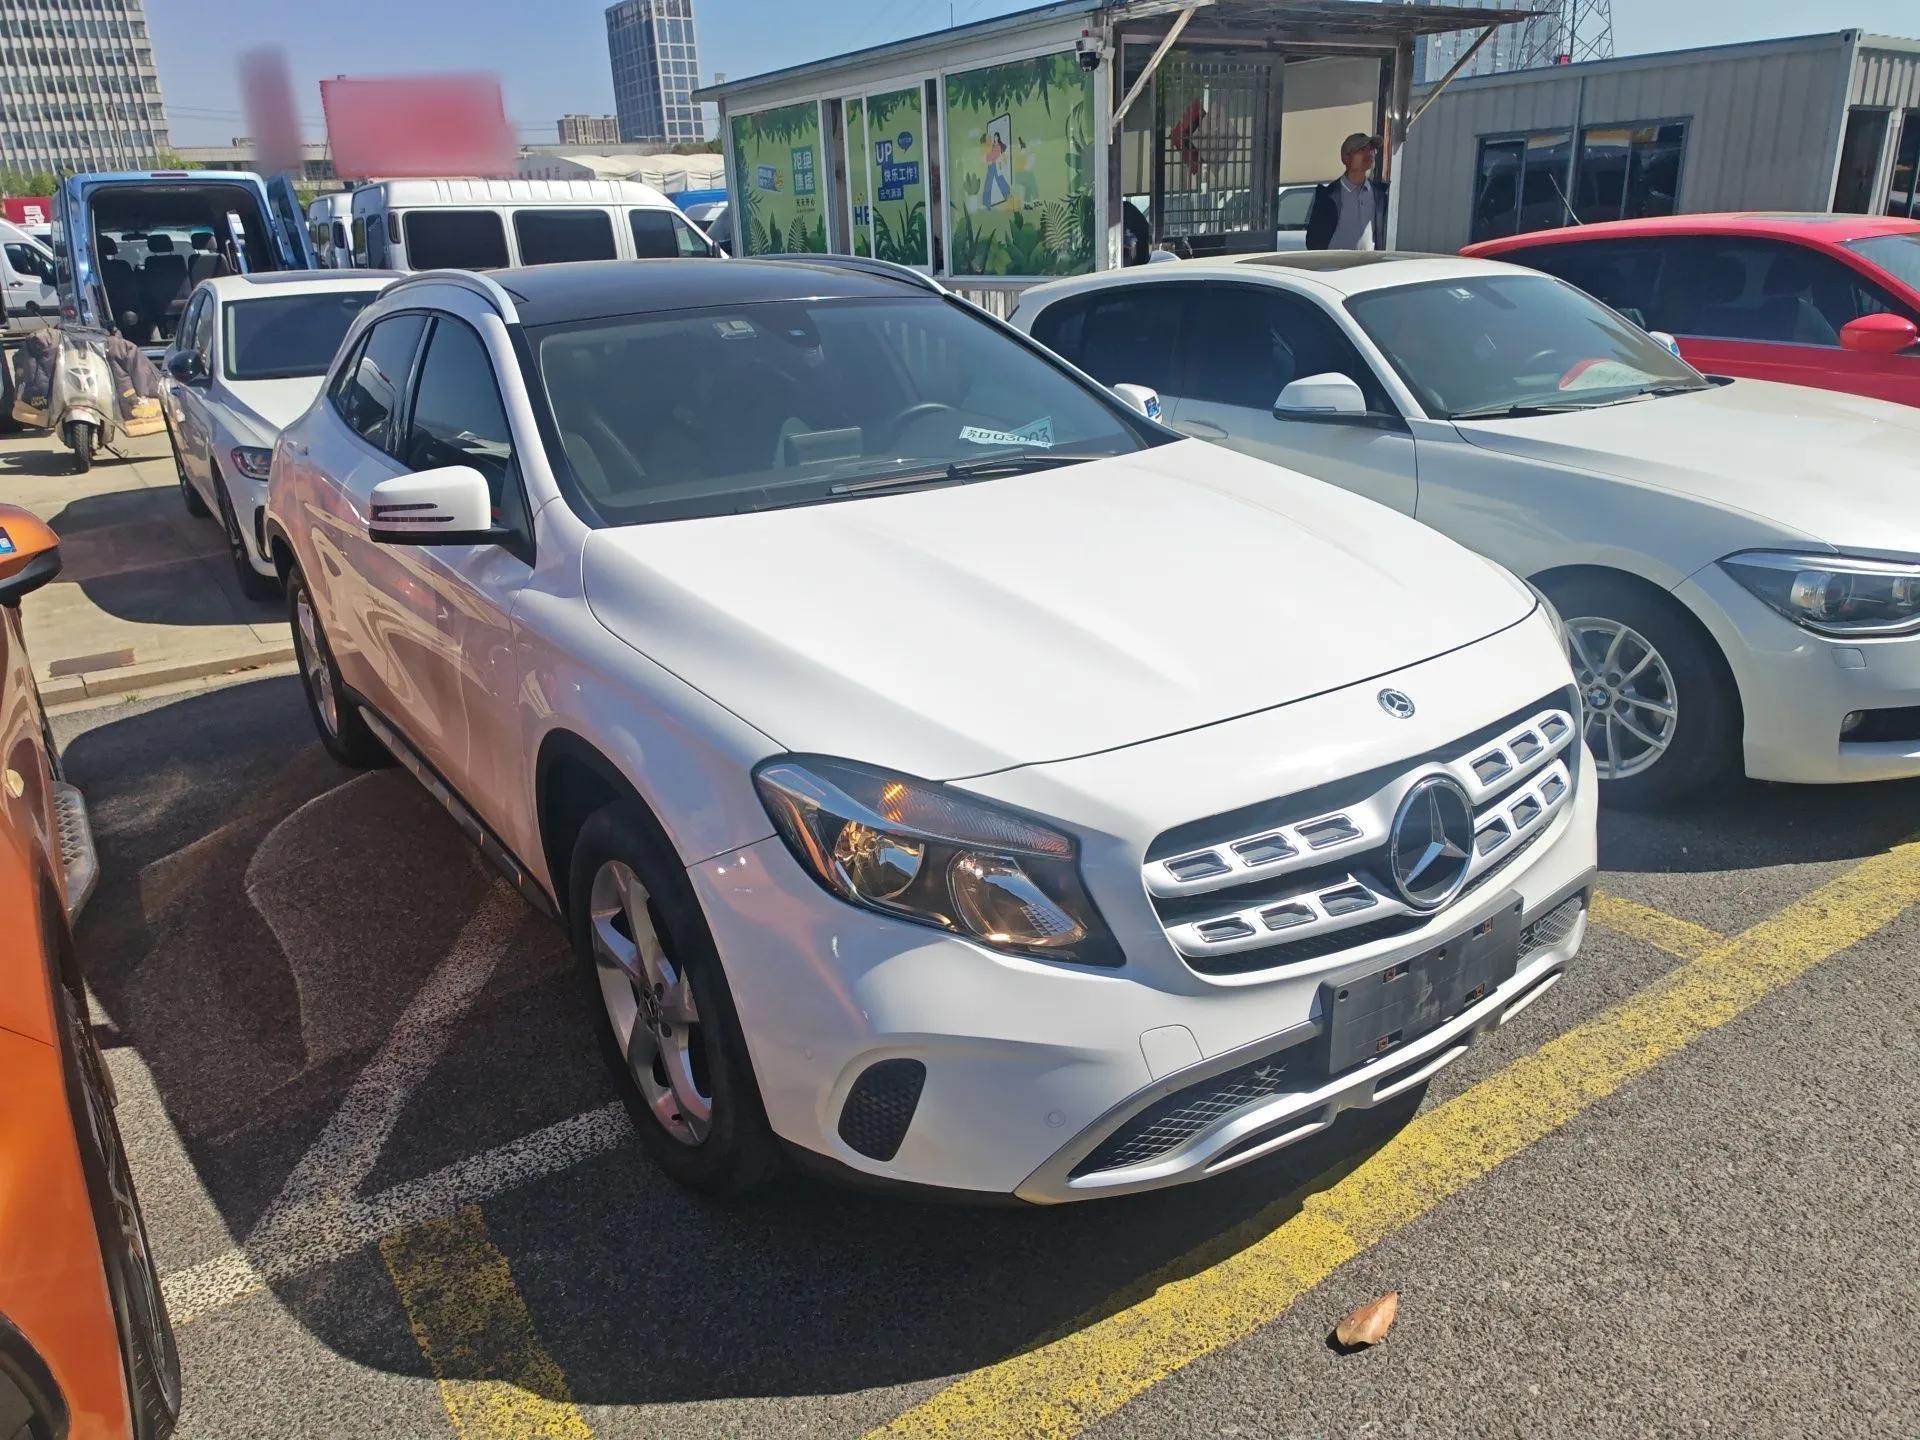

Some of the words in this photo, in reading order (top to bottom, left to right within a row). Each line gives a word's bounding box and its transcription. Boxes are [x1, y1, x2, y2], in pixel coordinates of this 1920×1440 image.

[876, 143, 892, 163] UP
[884, 166, 917, 182] 快乐工作!
